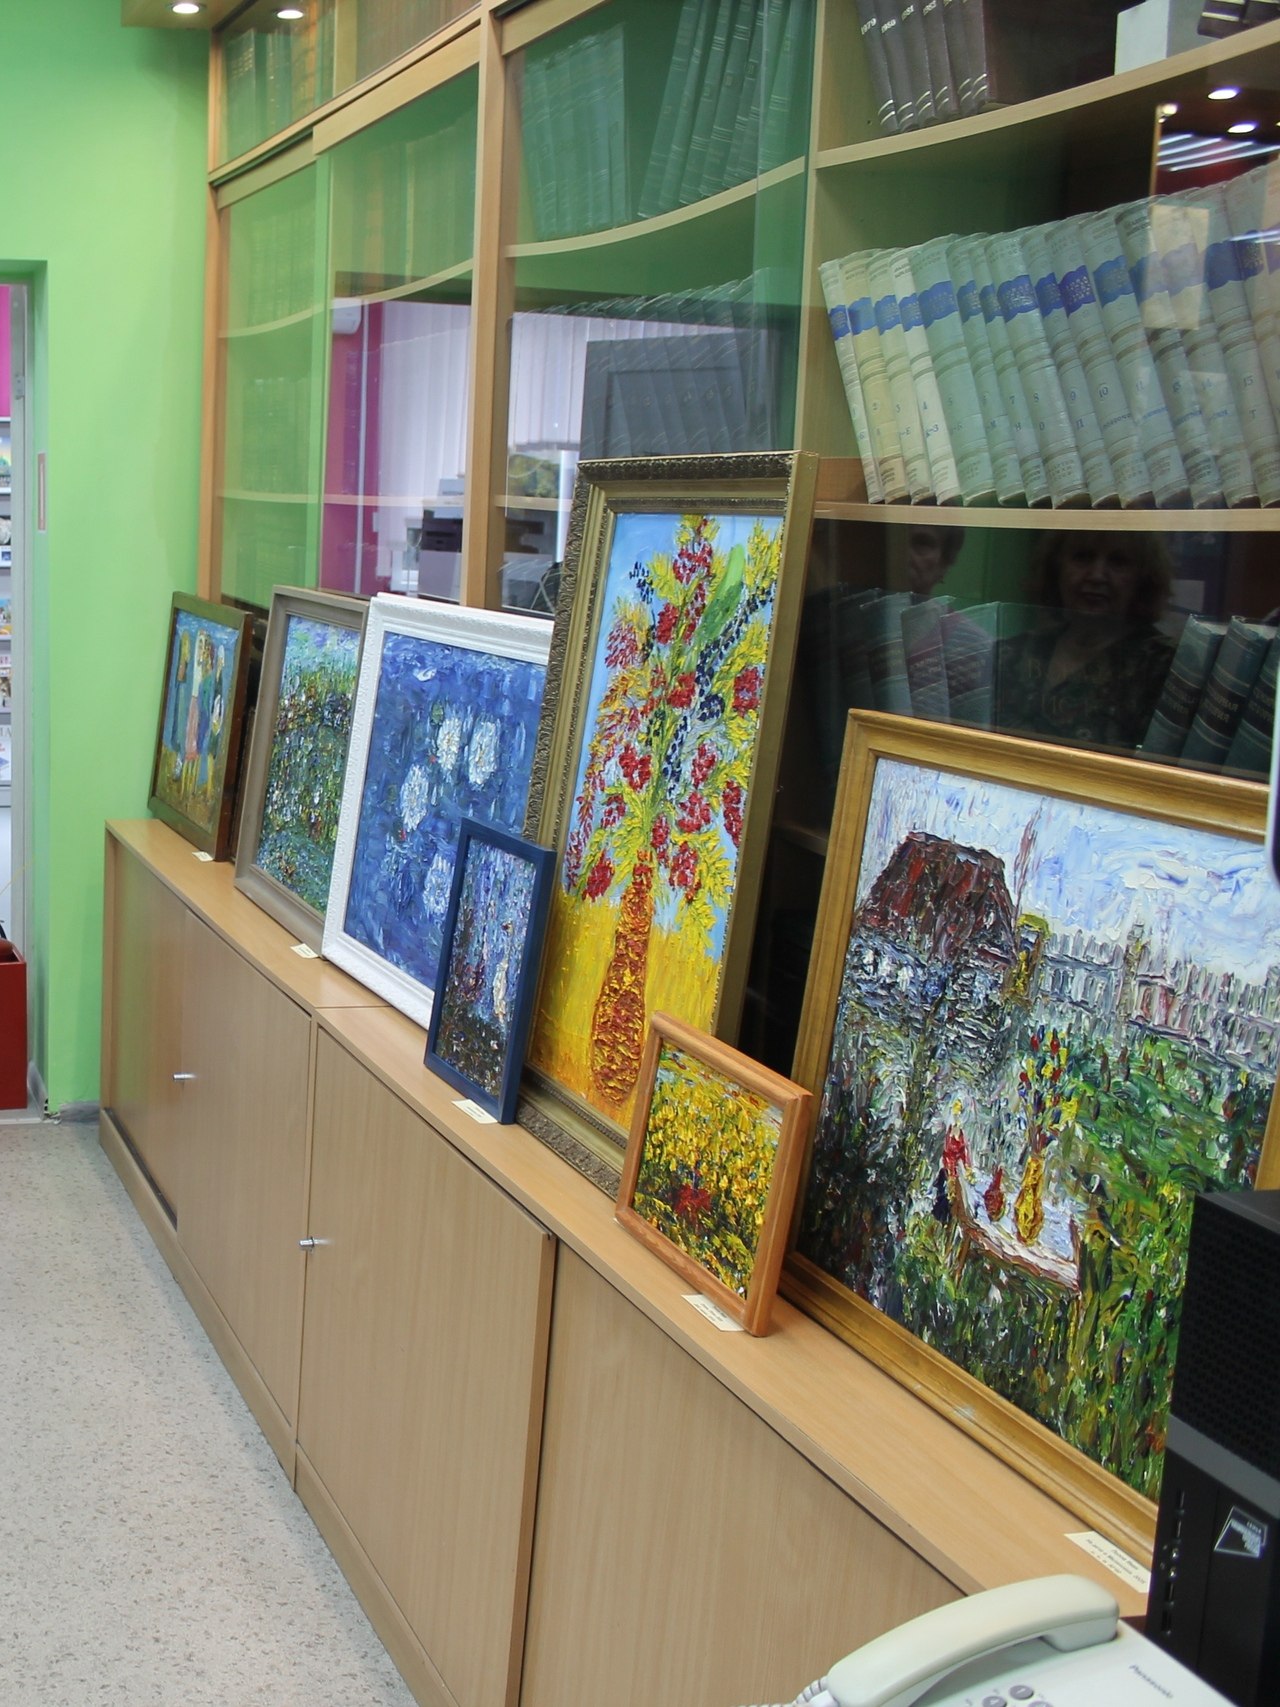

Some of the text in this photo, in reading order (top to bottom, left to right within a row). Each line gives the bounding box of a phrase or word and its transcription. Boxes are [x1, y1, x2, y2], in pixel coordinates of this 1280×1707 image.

[861, 17, 877, 35] 1979
[881, 19, 897, 34] 1980
[1243, 375, 1256, 389] 15
[1070, 390, 1077, 401] 9
[1099, 386, 1109, 399] 10
